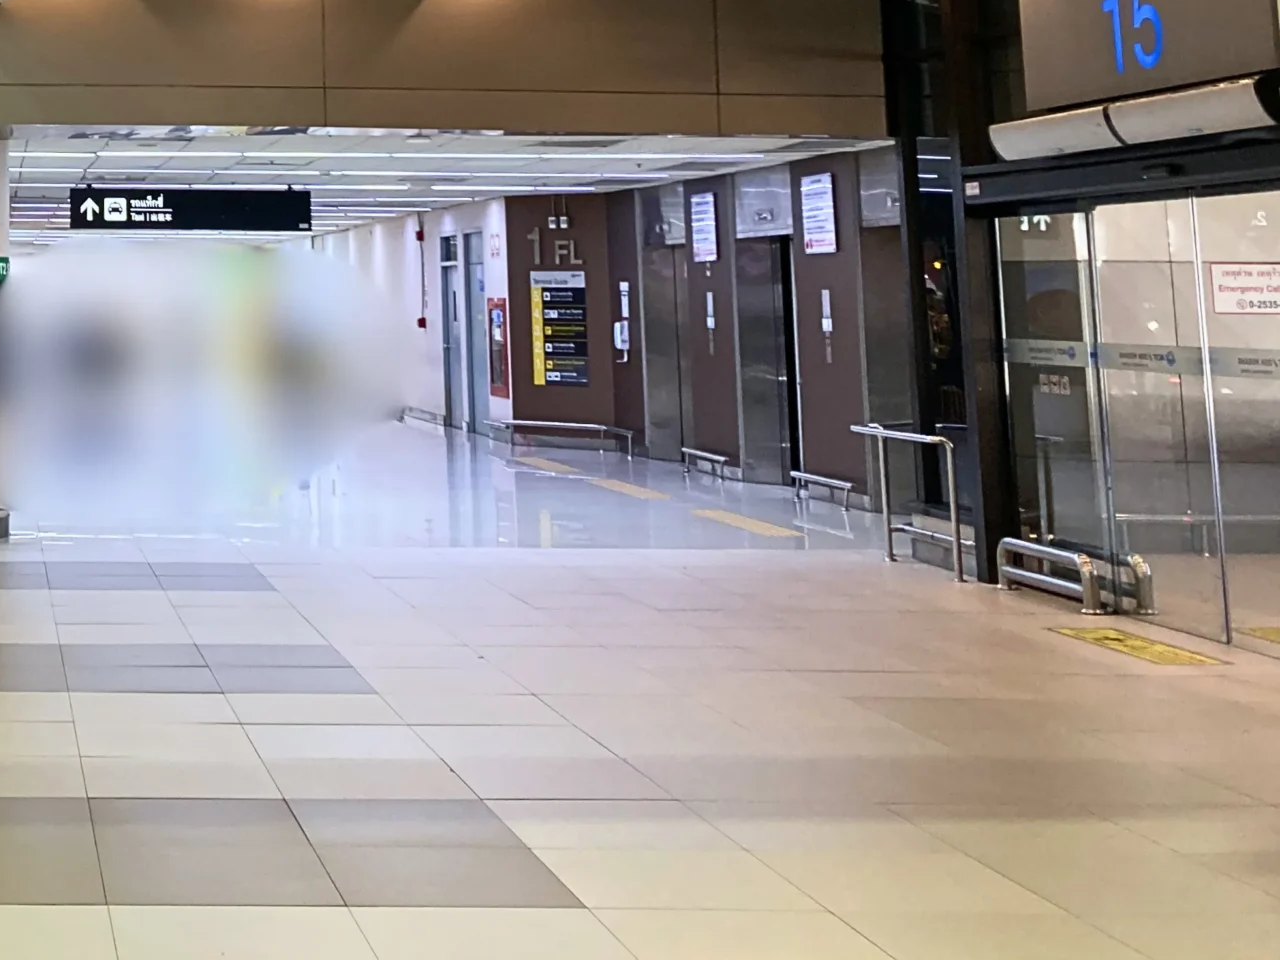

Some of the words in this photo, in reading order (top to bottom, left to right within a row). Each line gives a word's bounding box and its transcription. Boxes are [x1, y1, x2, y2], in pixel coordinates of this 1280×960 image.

[527, 227, 541, 265] 1
[554, 240, 583, 265] FL
[1218, 284, 1264, 295] Emergency
